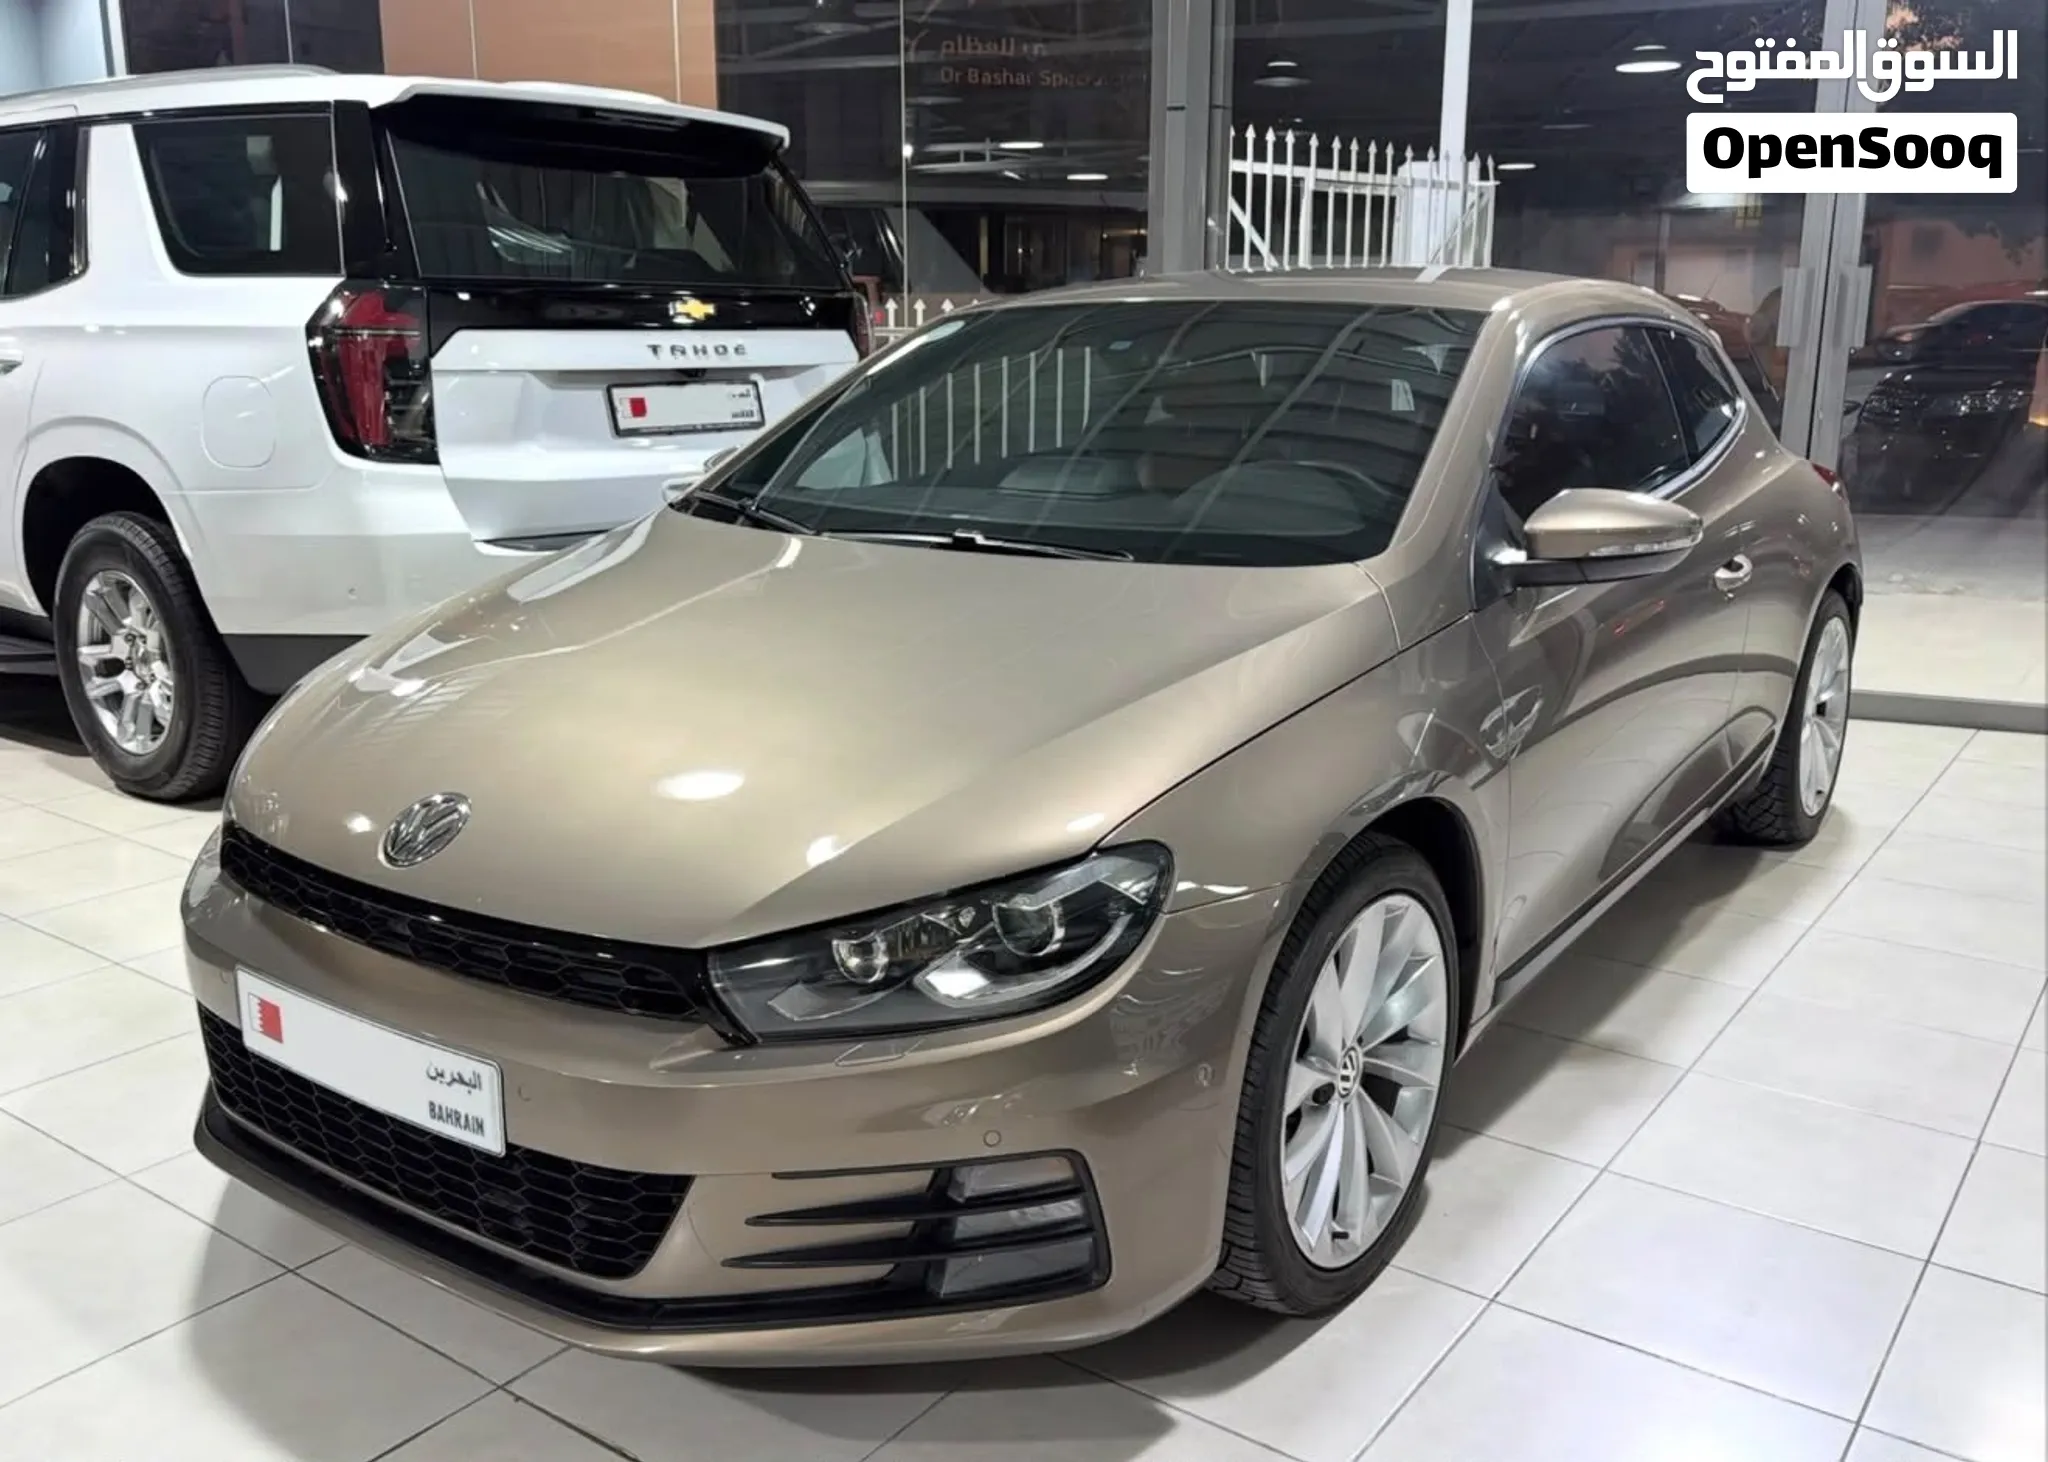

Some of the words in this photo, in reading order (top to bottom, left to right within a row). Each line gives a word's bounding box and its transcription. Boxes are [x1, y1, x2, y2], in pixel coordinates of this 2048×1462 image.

[941, 65, 961, 84] Dr
[967, 67, 1033, 87] Bashar
[647, 344, 746, 358] TAHOE
[426, 1062, 482, 1095] البحرين
[428, 1101, 485, 1137] BAHRAIN
